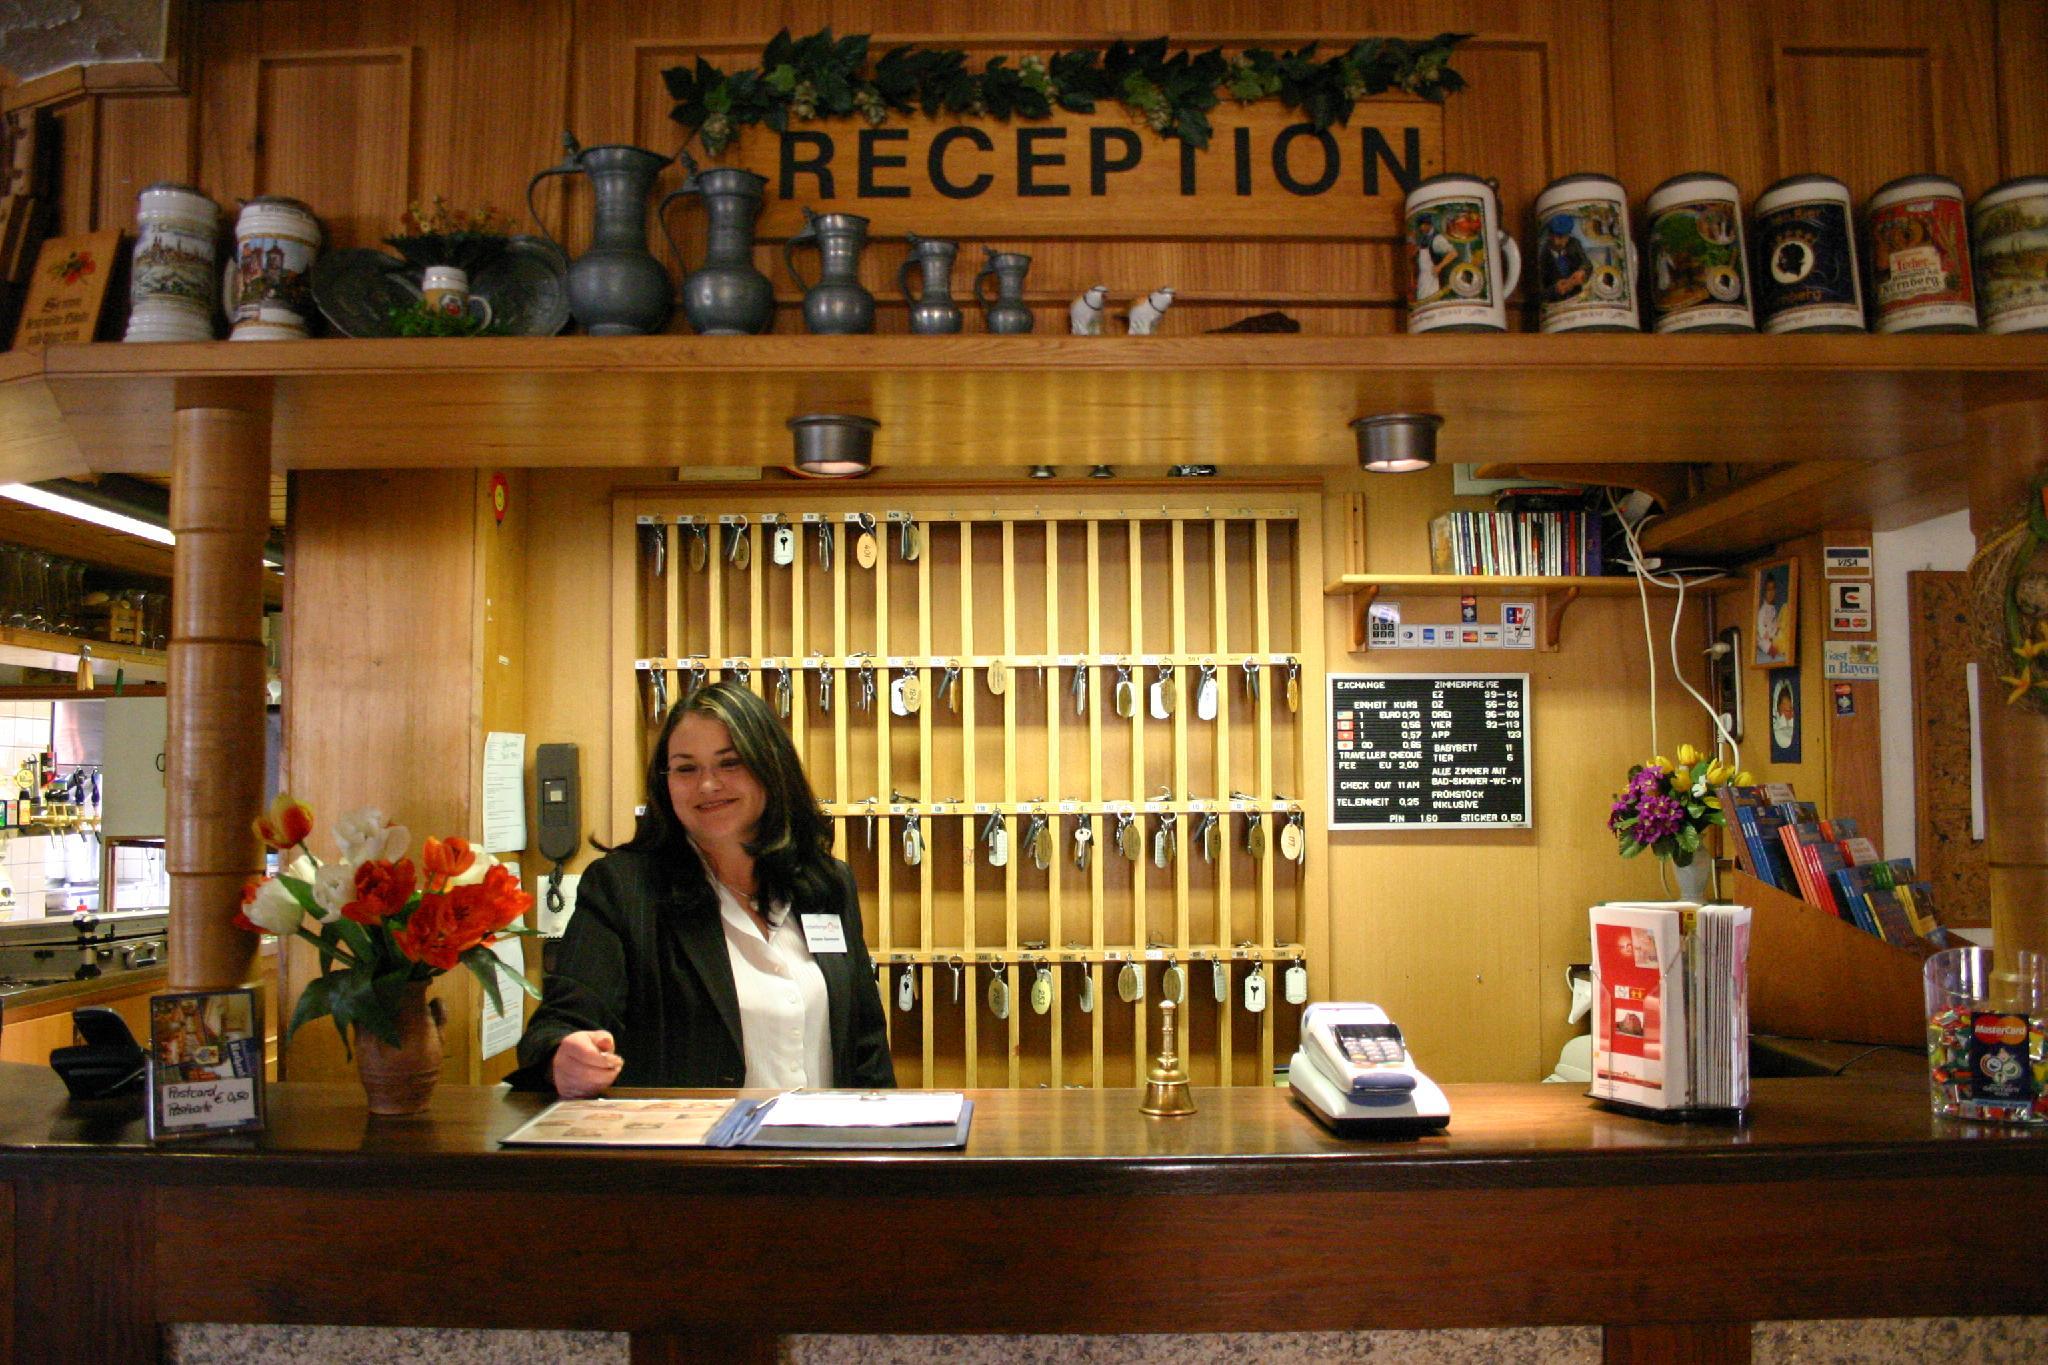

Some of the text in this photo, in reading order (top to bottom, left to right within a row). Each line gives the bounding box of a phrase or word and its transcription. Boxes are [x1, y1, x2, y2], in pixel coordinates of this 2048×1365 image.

[779, 122, 1420, 200] RECEPTION
[1840, 662, 1879, 676] Bayern
[1337, 681, 1386, 689] EXCHANGE
[1434, 680, 1500, 689] ZIMMERPREISE
[1432, 690, 1444, 699] EZ
[1353, 701, 1418, 709] EINHEIT KURS
[1431, 700, 1444, 709] DZ
[1360, 711, 1364, 719] 1
[1379, 711, 1401, 719] EURO
[1431, 710, 1452, 719] DREI
[1360, 721, 1364, 729] 1
[1430, 720, 1452, 729] VIER
[1360, 731, 1365, 739] 1
[1431, 730, 1522, 739] APP 123
[1433, 743, 1513, 752] BABYBETT 11
[1339, 751, 1423, 760] TRAVELLER CHEQUE
[1433, 753, 1514, 762] TIER 6
[1338, 761, 1357, 770] FEE
[1379, 761, 1392, 769] EU
[1432, 767, 1507, 775] ALLE ZIMMER MIT
[1340, 781, 1369, 790] CHECK
[1374, 781, 1392, 789] OUT
[1432, 800, 1479, 809] INKLUSIVE
[1389, 814, 1405, 823] PIN
[1460, 813, 1498, 822] STICKER
[1974, 1024, 2026, 1035] MasterCard
[168, 1084, 218, 1100] Postcard
